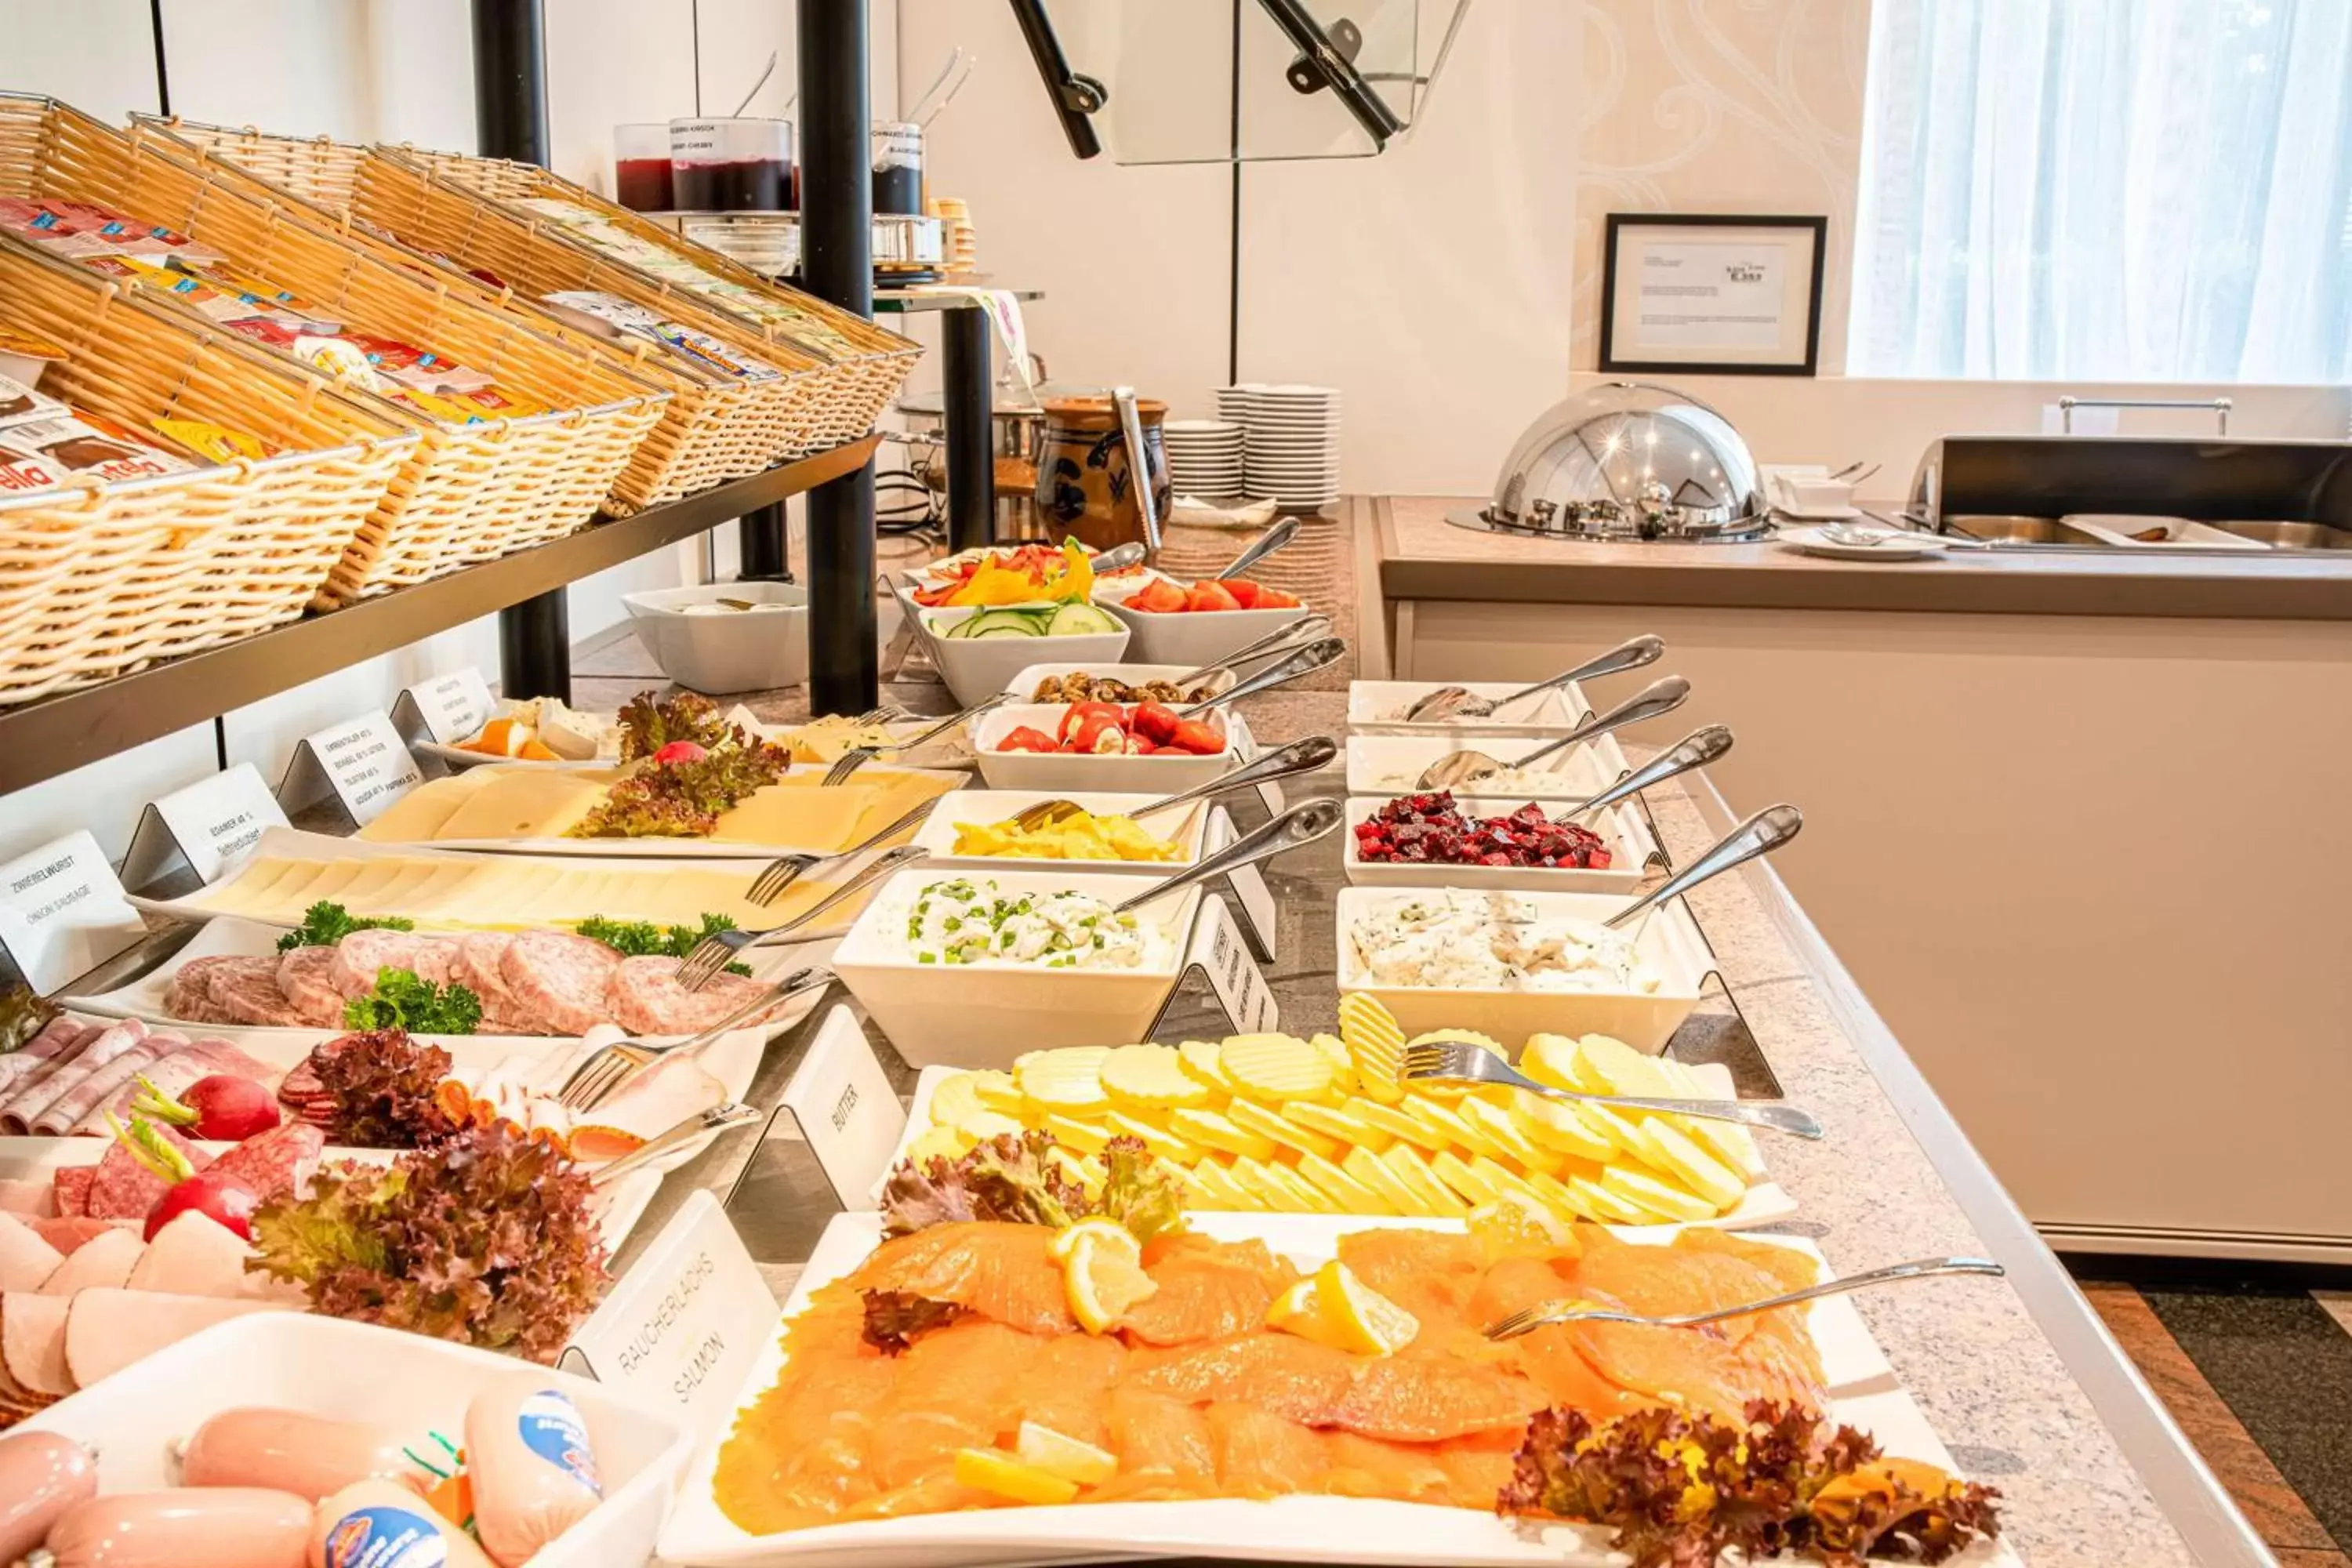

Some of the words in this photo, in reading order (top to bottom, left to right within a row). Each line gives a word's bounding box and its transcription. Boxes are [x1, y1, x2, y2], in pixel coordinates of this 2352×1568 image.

[11, 855, 74, 893] ZWIEBELWURST
[831, 1083, 859, 1134] BUTTER
[673, 1331, 726, 1404] SALMON
